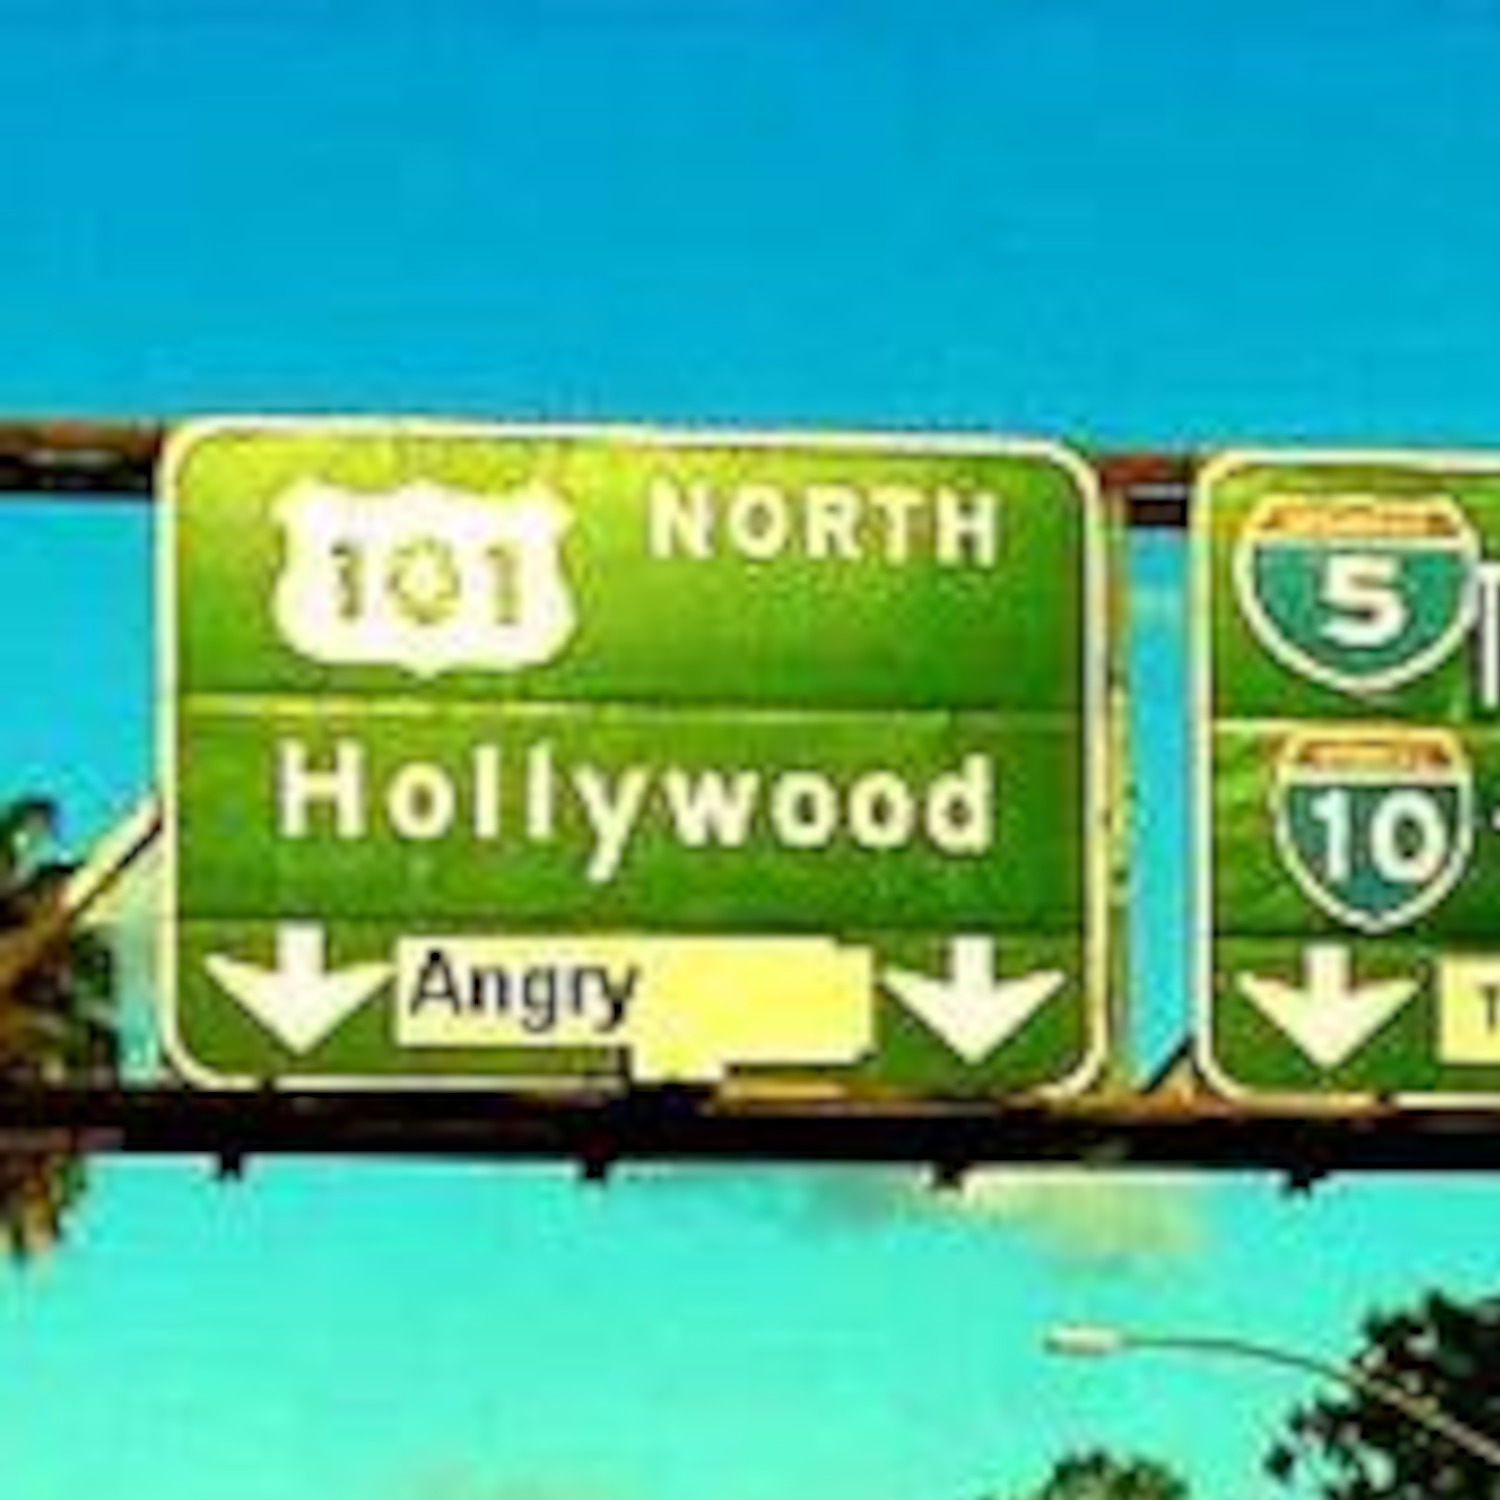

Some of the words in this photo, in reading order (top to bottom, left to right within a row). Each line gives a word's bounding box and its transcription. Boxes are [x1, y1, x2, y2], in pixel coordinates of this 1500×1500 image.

[647, 477, 997, 567] NORTH
[328, 542, 521, 625] 101
[1320, 555, 1408, 646] 5
[278, 738, 993, 883] Hollywood
[1309, 788, 1448, 883] 10
[408, 947, 640, 1032] Angry
